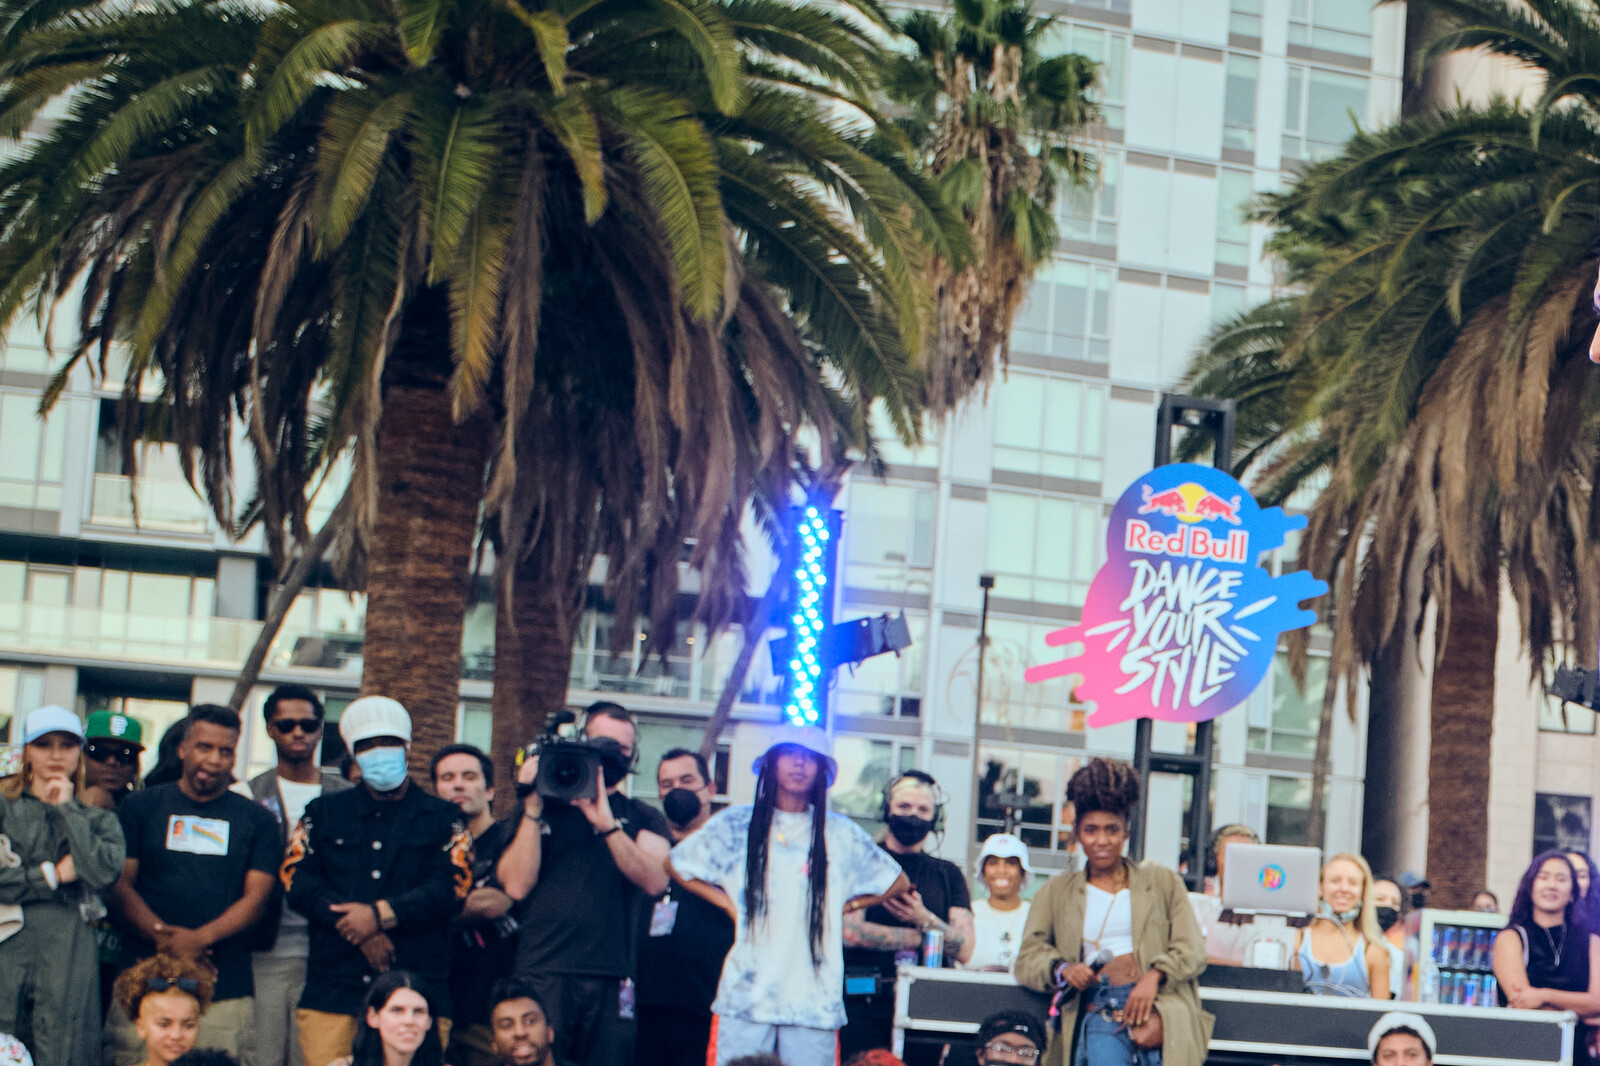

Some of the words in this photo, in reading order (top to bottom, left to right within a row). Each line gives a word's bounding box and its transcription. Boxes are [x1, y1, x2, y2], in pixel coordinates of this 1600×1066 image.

[1128, 522, 1187, 554] Red
[1190, 529, 1246, 561] Bull
[1119, 559, 1244, 614] DANCE
[1127, 595, 1249, 657] YOUR
[1114, 633, 1241, 711] STYLE
